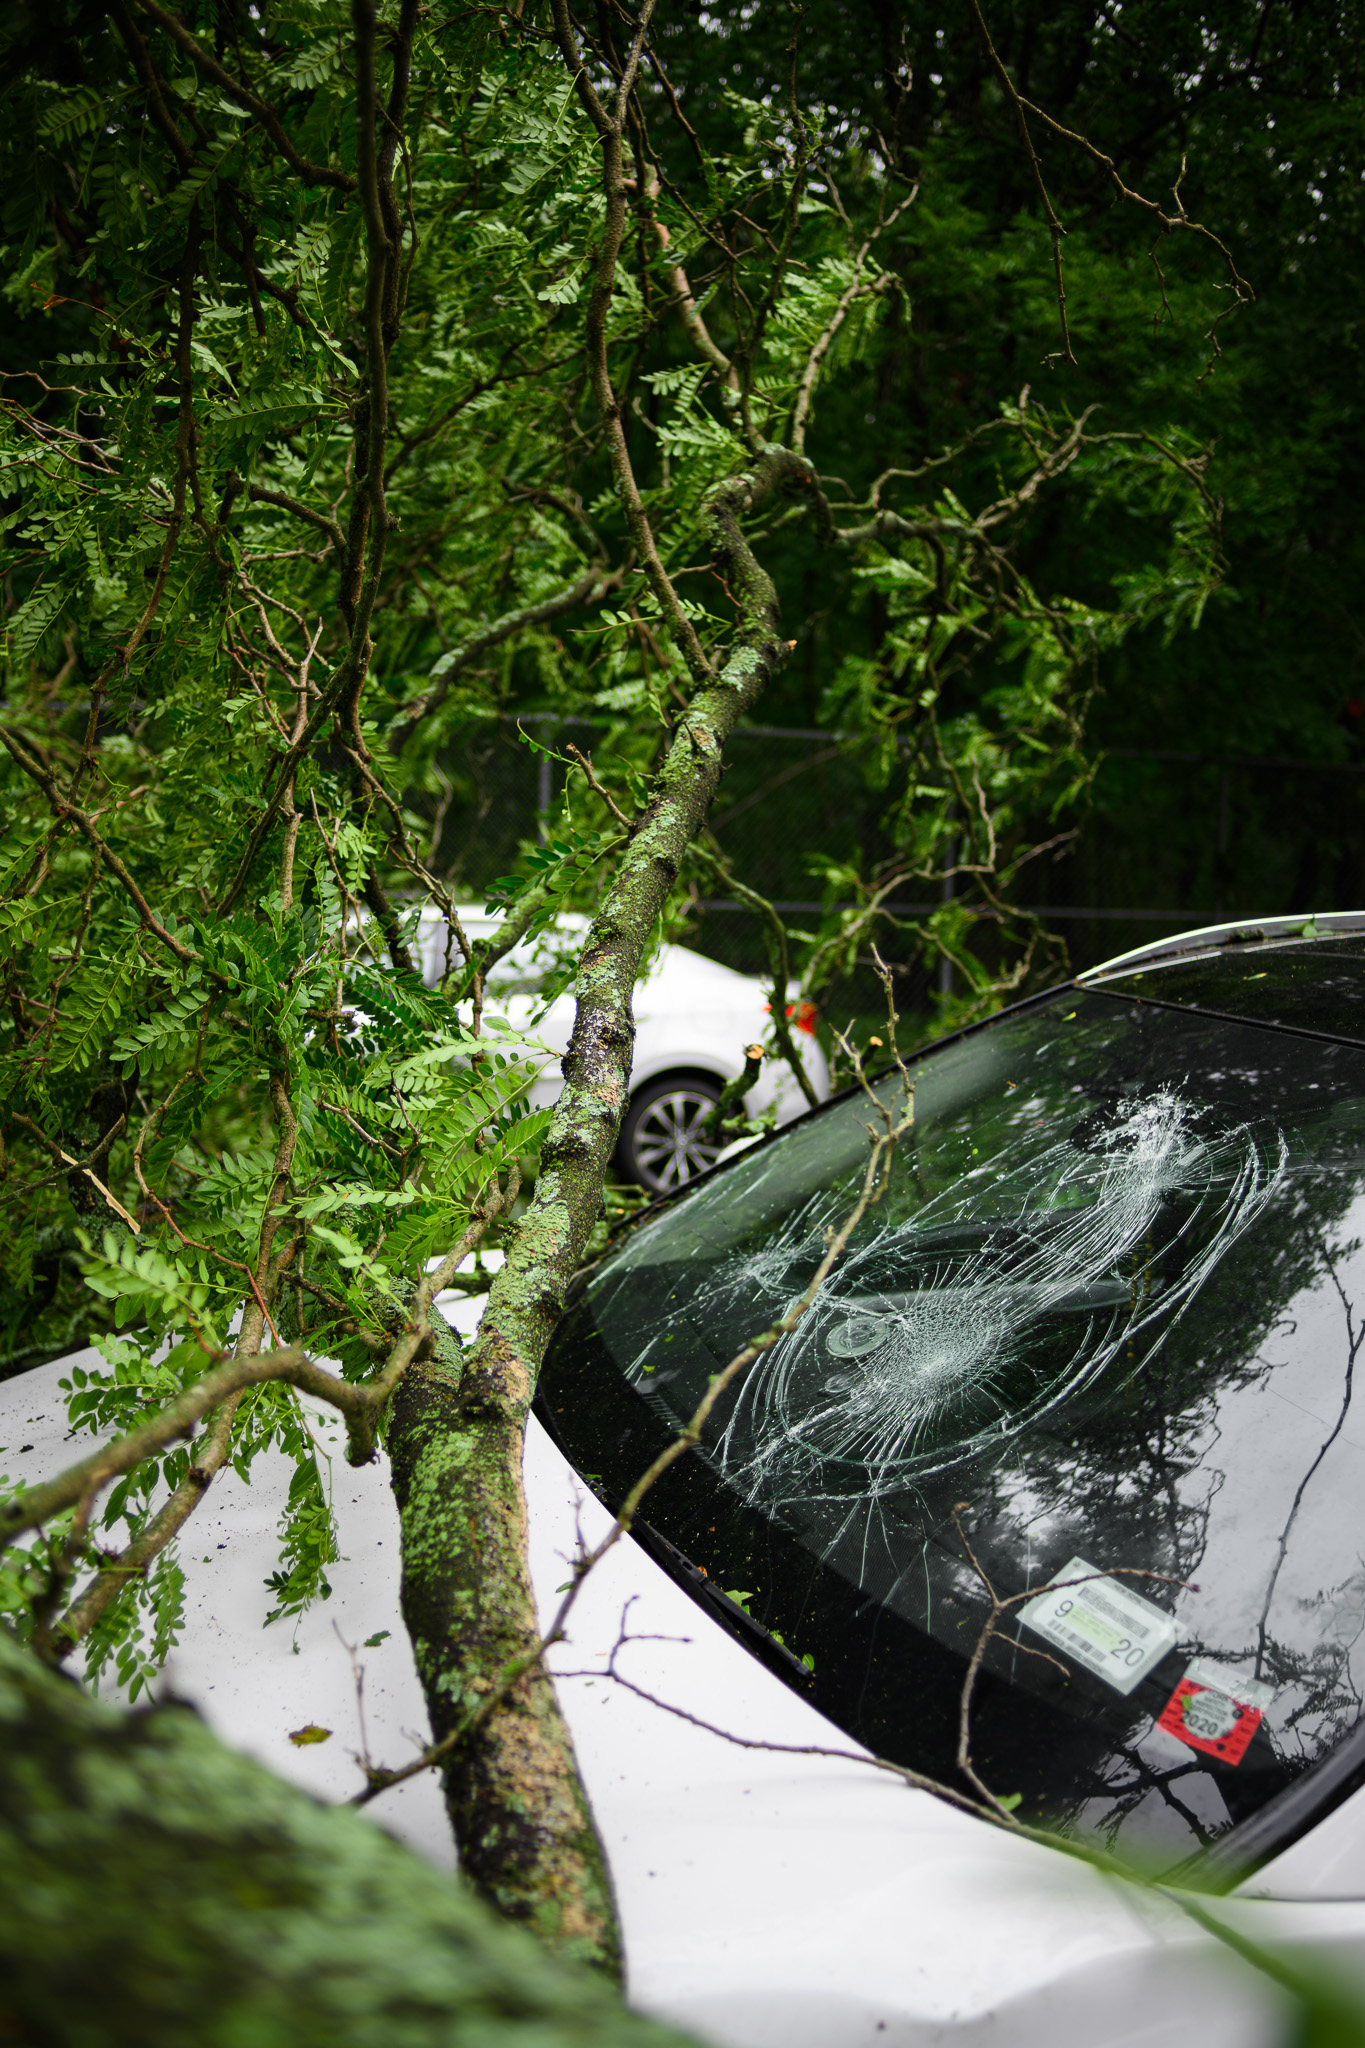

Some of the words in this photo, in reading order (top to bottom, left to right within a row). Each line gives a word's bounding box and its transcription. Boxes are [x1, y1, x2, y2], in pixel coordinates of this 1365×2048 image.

[1054, 1600, 1074, 1618] 9
[1110, 1638, 1145, 1667] 20
[1179, 1709, 1219, 1736] 2020
